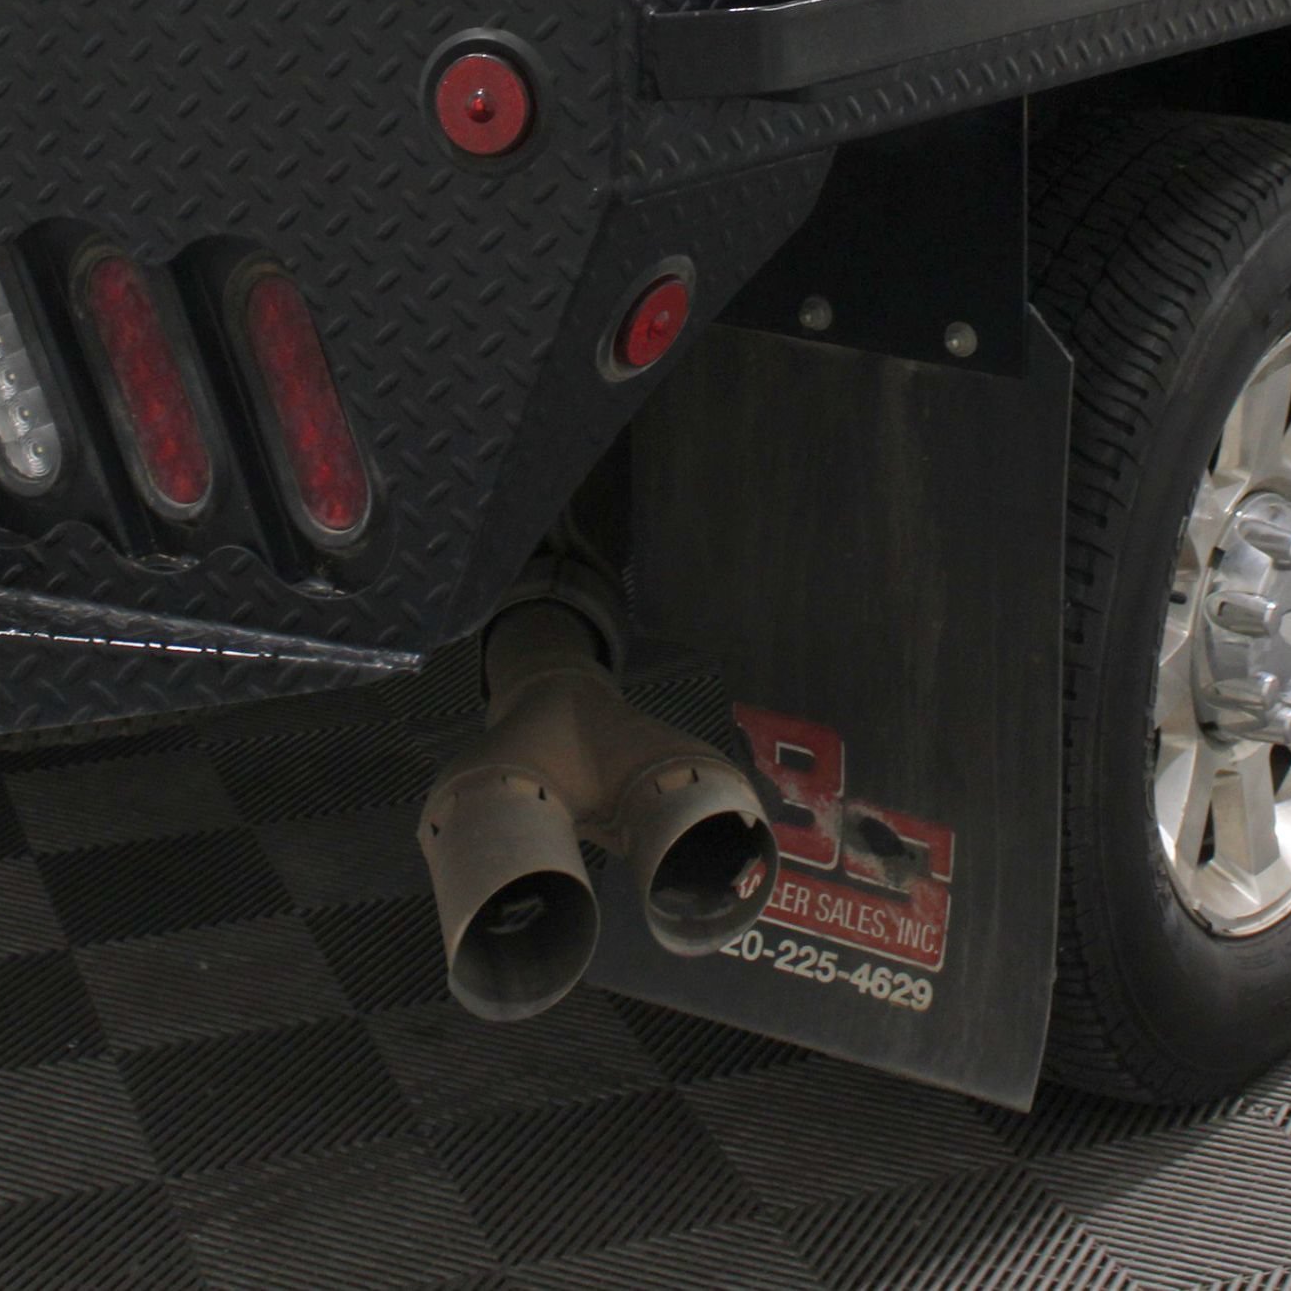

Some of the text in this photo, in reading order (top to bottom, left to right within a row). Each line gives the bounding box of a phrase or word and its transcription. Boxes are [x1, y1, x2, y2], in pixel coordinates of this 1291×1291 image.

[815, 893, 889, 945] SALES,
[897, 917, 938, 954] INC.
[719, 930, 933, 1011] 20-225-4629
